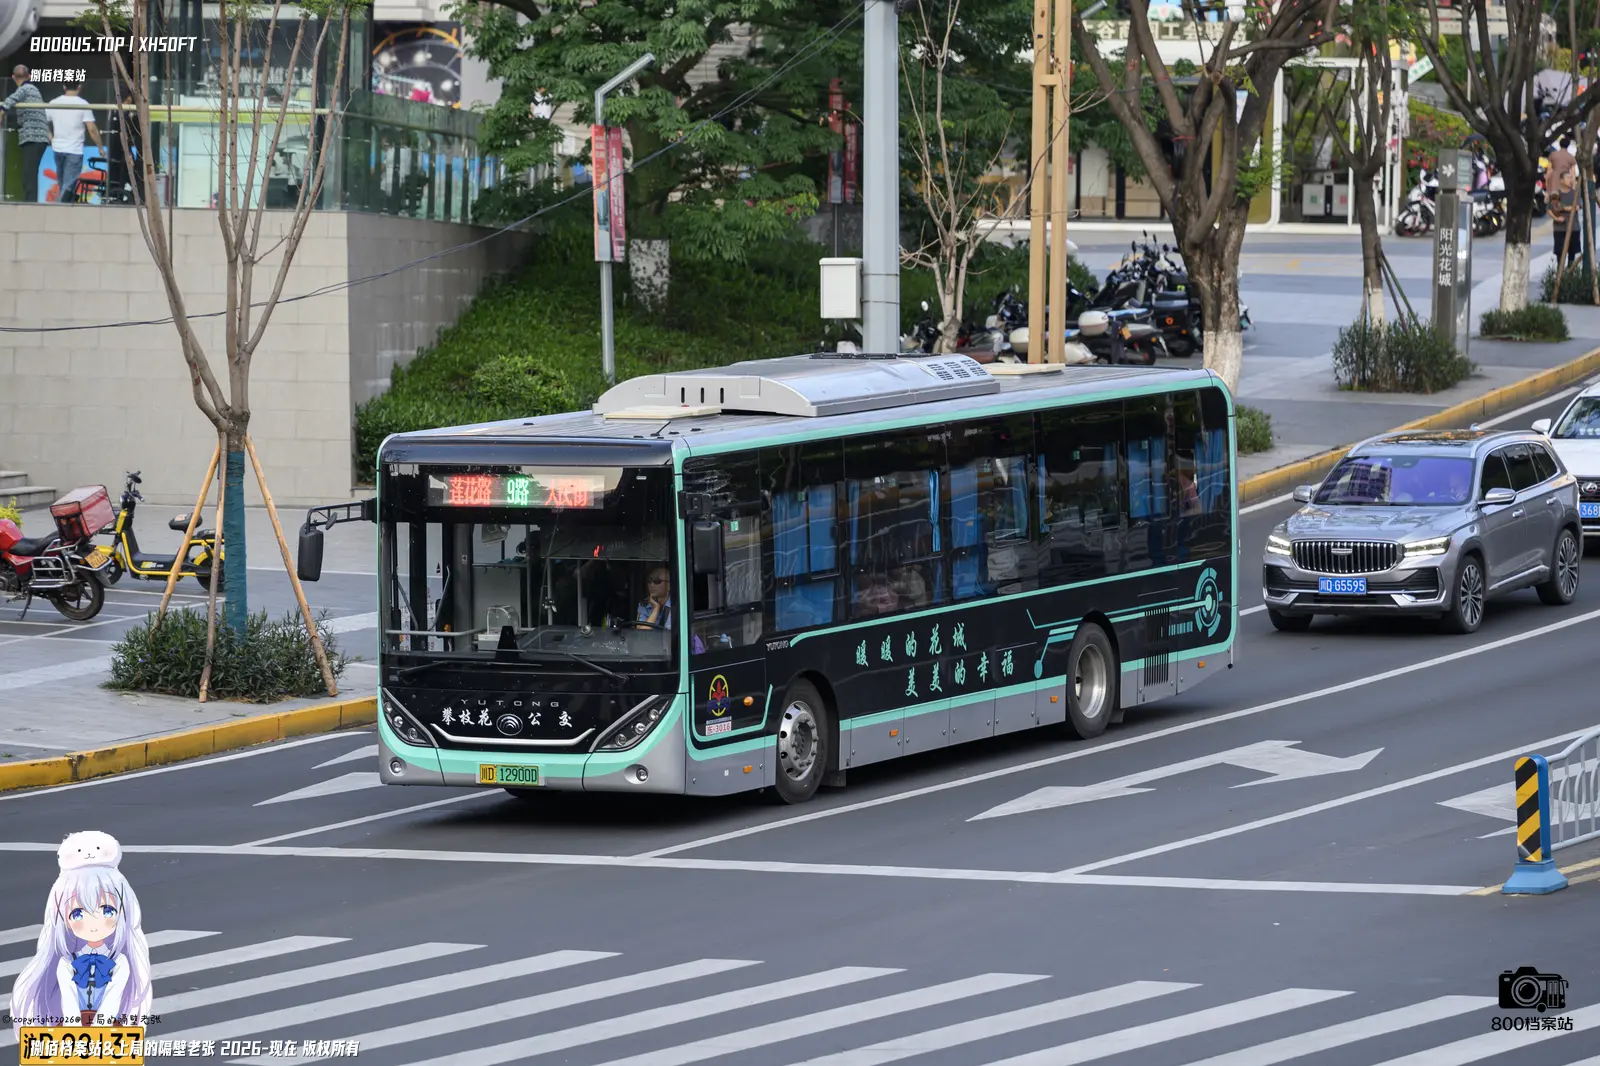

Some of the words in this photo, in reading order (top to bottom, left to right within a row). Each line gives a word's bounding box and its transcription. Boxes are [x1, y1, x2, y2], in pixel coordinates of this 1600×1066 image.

[1438, 227, 1453, 287] 阳光花城
[449, 477, 492, 506] 莲花路
[507, 478, 529, 506] 9路
[1581, 504, 1600, 517] 368
[855, 622, 967, 668] 暖暖的花城
[905, 649, 1015, 698] 美美的幸福
[441, 706, 493, 727] 攀枝花
[527, 710, 573, 728] 公交
[460, 698, 560, 708] YUTONG
